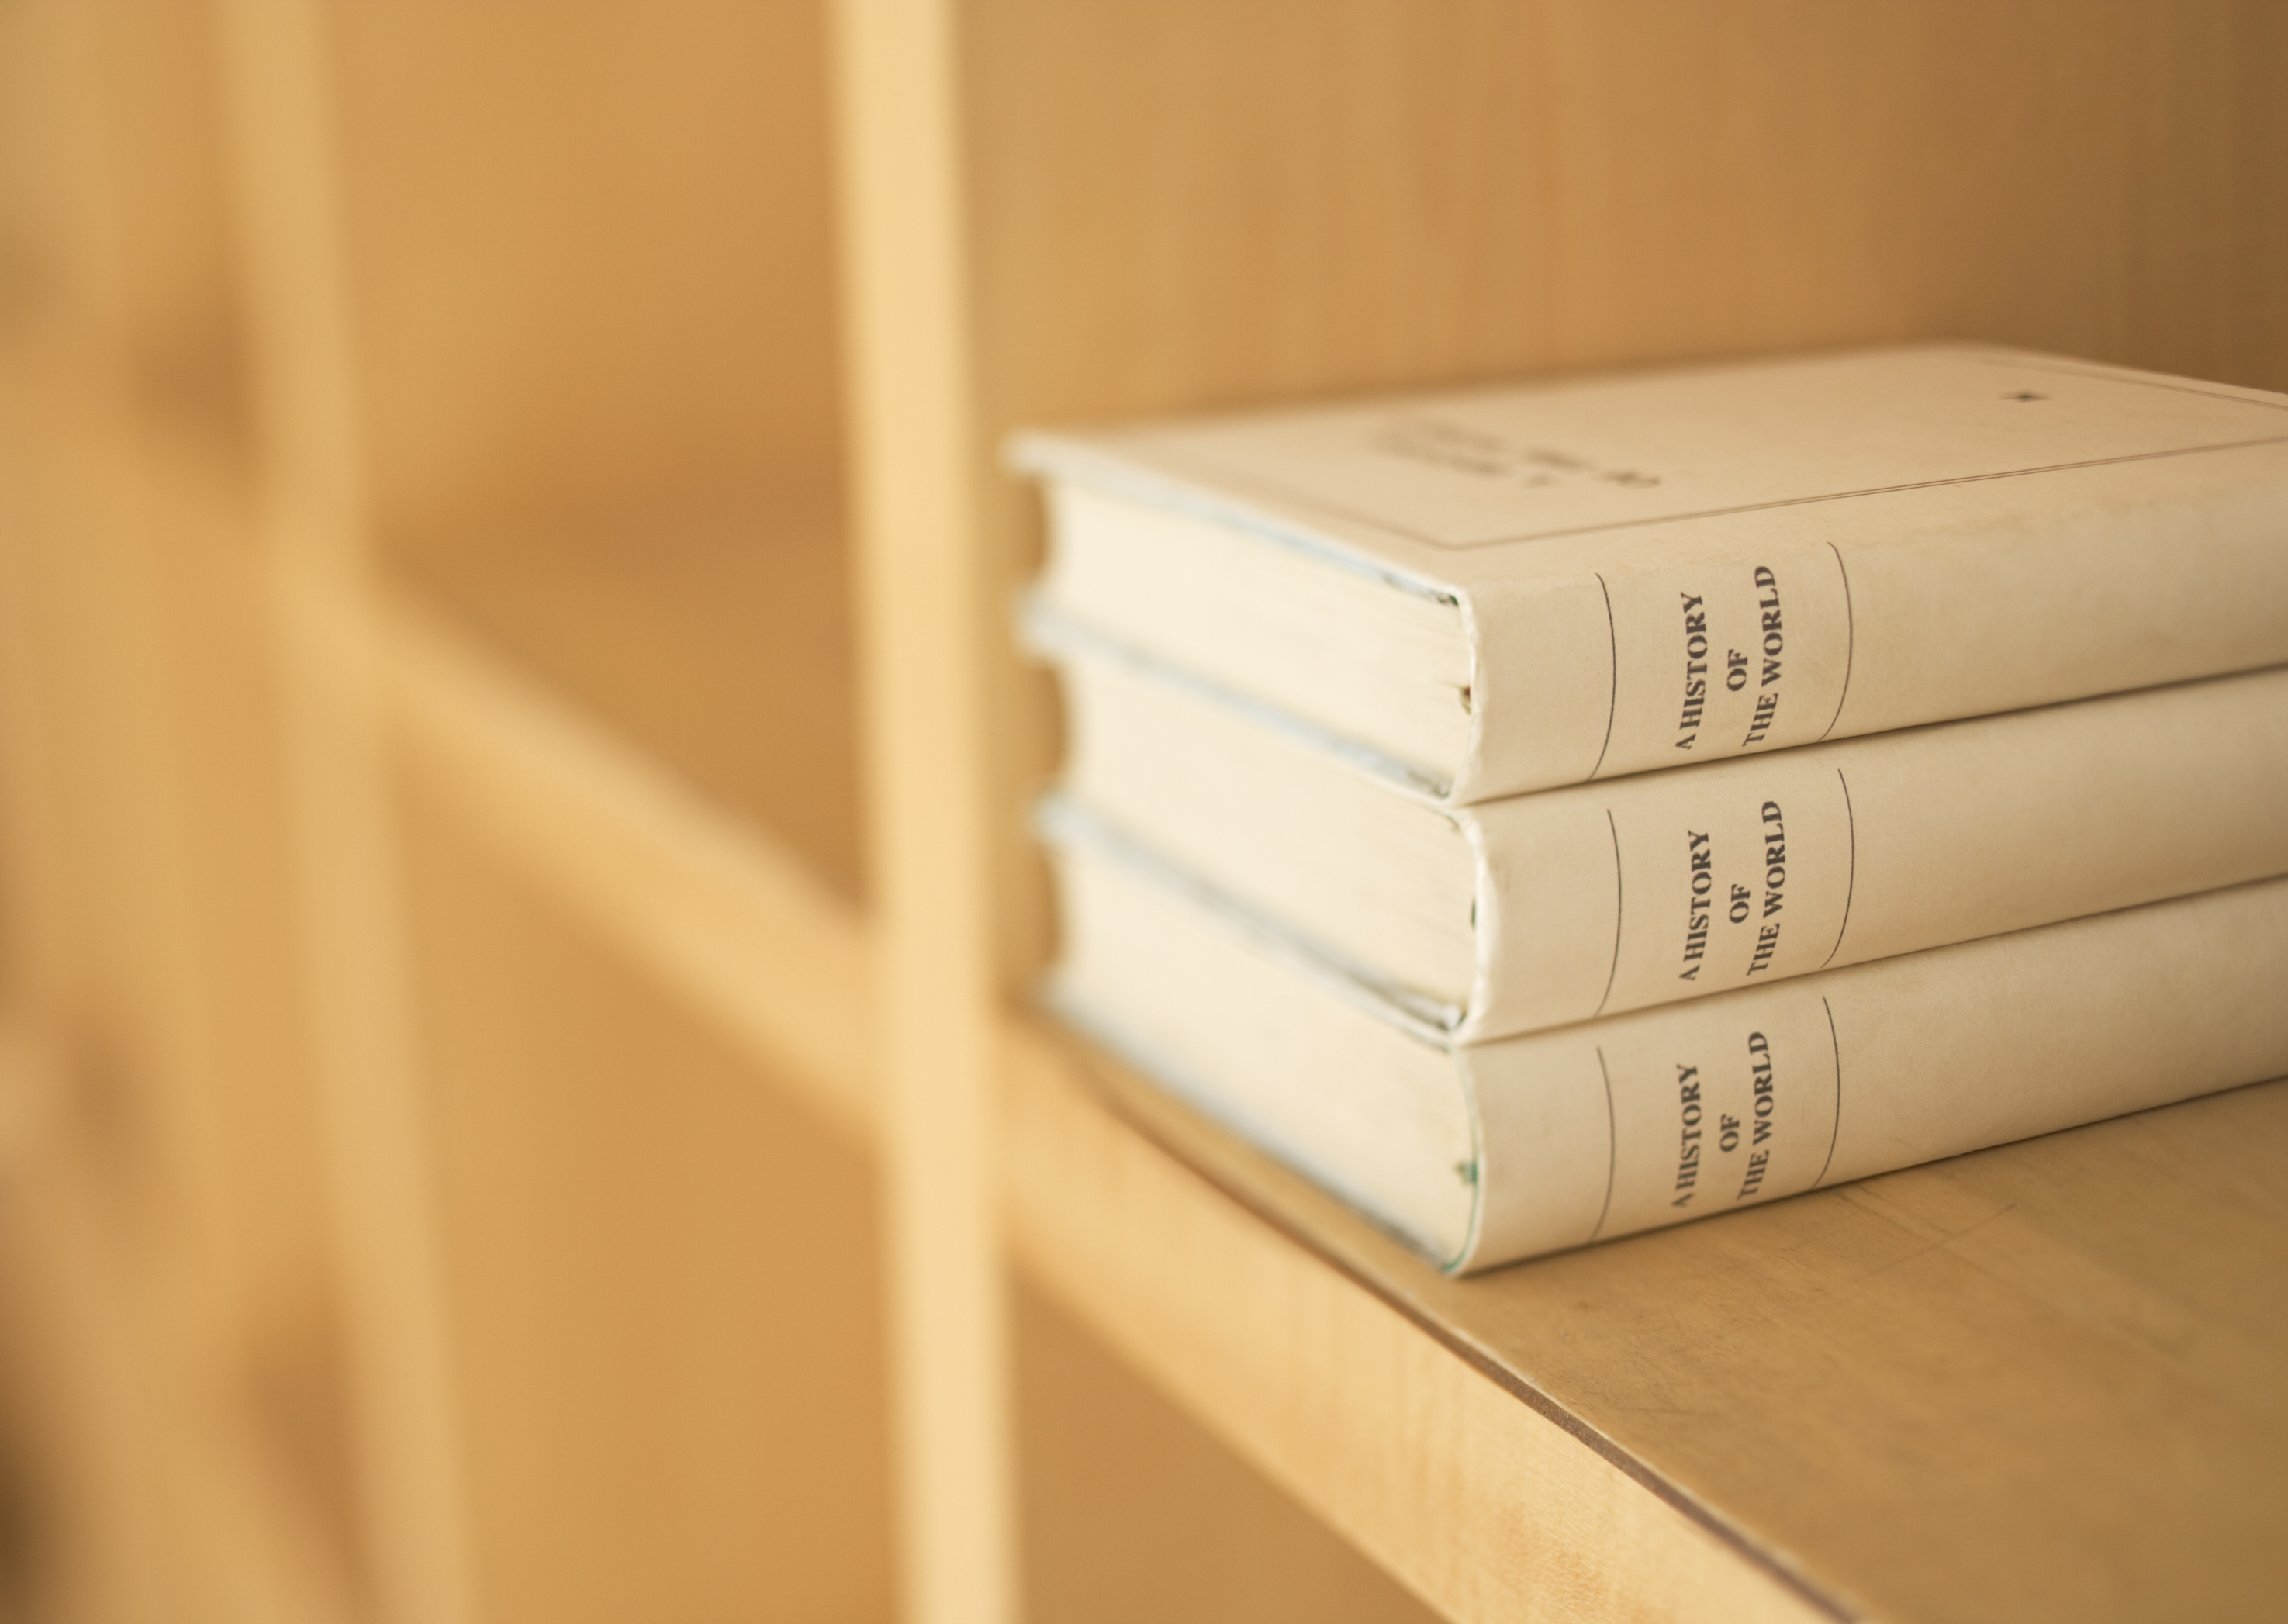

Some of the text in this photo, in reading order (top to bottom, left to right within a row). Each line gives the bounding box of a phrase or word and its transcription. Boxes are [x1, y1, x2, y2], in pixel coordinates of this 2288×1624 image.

[1675, 591, 1707, 750] A HISTORY
[1726, 649, 1747, 692] OF
[1742, 566, 1783, 747] THE WORLD
[1678, 830, 1712, 980] A HISTORY
[1729, 884, 1751, 923] OF
[1746, 801, 1785, 976] THE WORLD
[1671, 1063, 1702, 1207] A HISTORY
[1719, 1114, 1740, 1152] OF
[1737, 1031, 1774, 1201] THE WORLD
